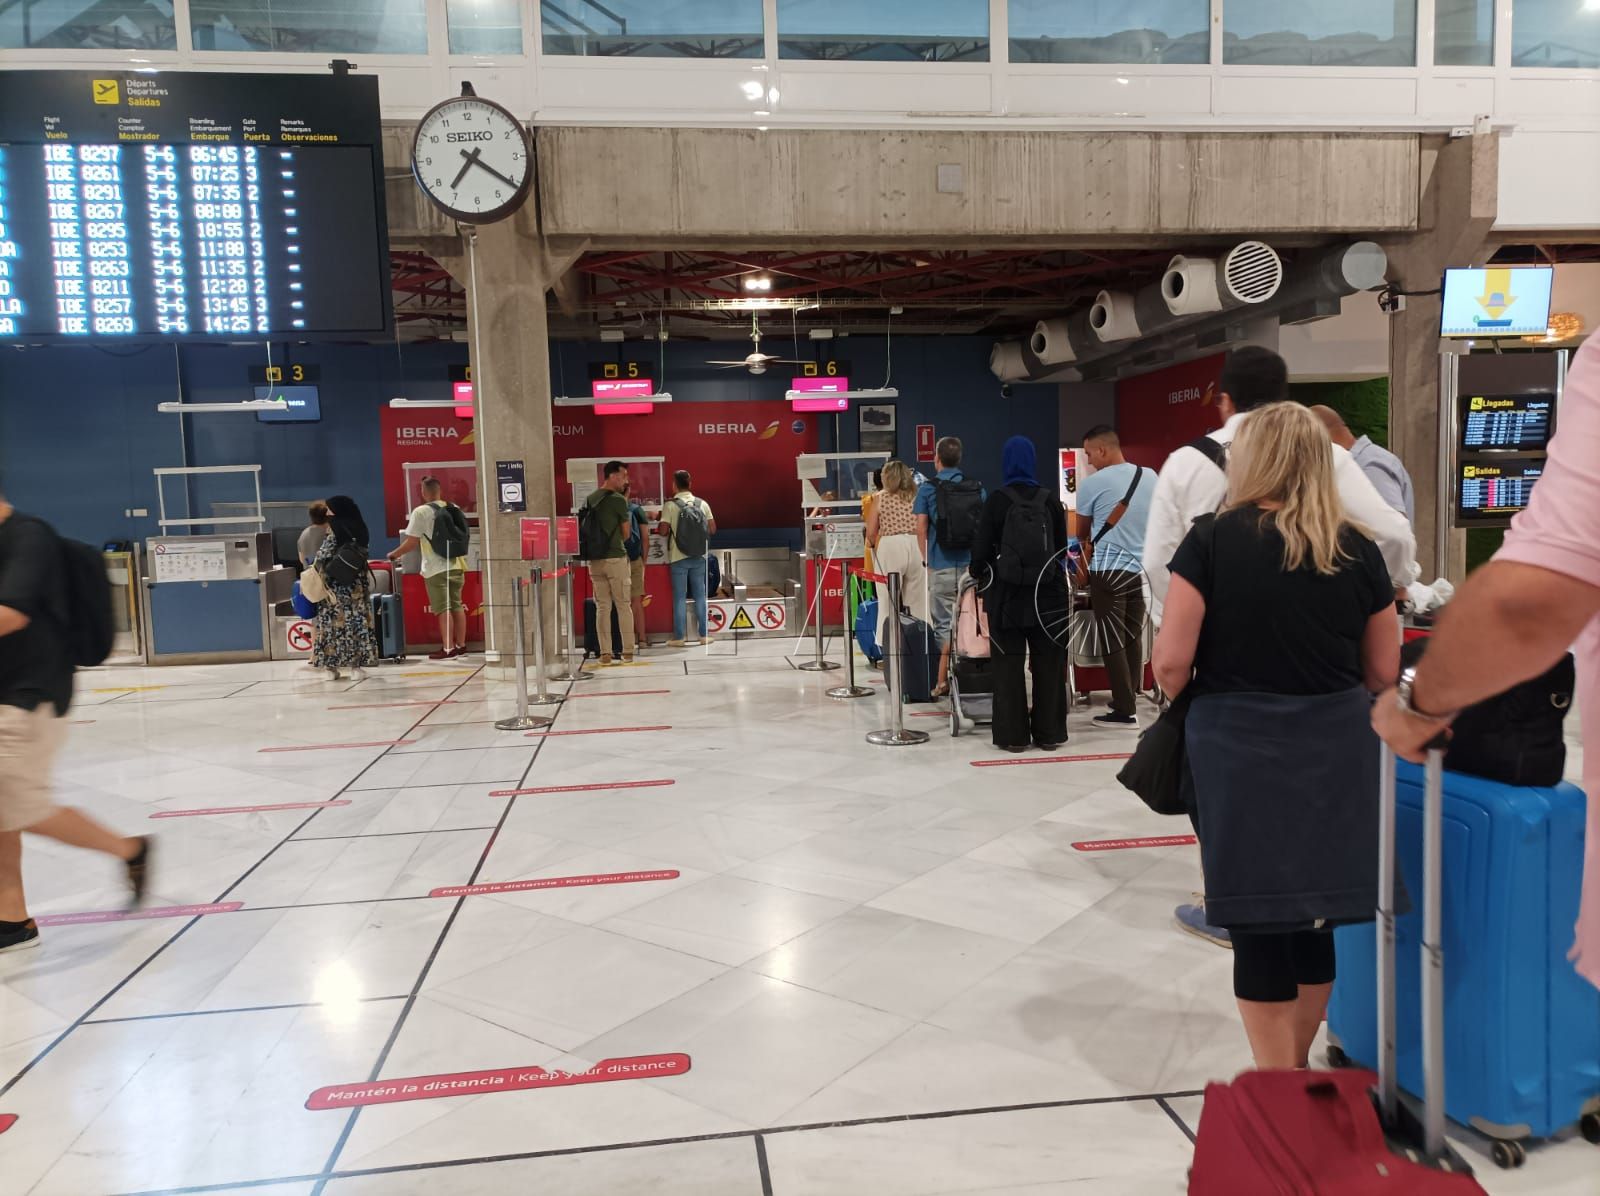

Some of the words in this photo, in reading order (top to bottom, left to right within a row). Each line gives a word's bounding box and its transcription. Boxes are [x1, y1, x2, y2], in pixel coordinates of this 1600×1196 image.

[127, 87, 168, 96] Departures
[128, 96, 160, 106] Salidas
[462, 112, 472, 121] 12
[442, 119, 449, 127] 11
[45, 131, 68, 139] Vuelo
[118, 132, 160, 140] Mostrador
[190, 133, 230, 141] Embarque
[243, 133, 271, 141] Puerta
[281, 133, 338, 141] Observaciones
[430, 135, 439, 144] 10
[446, 130, 493, 143] SEIKO
[504, 131, 511, 140] 2
[44, 144, 75, 161] IBE
[144, 146, 176, 162] 5-6
[245, 147, 257, 163] 2
[512, 152, 519, 161] 3
[425, 157, 432, 166] 9
[45, 164, 76, 181] IBE
[146, 165, 178, 181] 5-6
[246, 166, 259, 181] 3
[435, 178, 442, 187] 8
[48, 184, 78, 200] IBE
[147, 184, 179, 200] 5-6
[248, 185, 260, 200] 2
[495, 190, 501, 198] 5
[474, 196, 480, 205] 6
[49, 203, 80, 219] IBE
[149, 203, 180, 219] 5-6
[250, 204, 260, 219] 1
[50, 222, 81, 238] IBE
[150, 222, 182, 238] 5-6
[250, 222, 263, 238] 2
[52, 241, 83, 257] IBE
[151, 241, 184, 256] 5-6
[252, 241, 264, 257] 3
[54, 260, 84, 276] IBE
[153, 260, 185, 275] 5-6
[253, 260, 265, 275] 2
[55, 280, 86, 295] IBE
[155, 279, 186, 294] 5-6
[255, 278, 266, 294] 2
[57, 298, 88, 314] IBE
[156, 297, 188, 313] 5-6
[256, 297, 268, 312] 3
[59, 317, 89, 333] IBE
[158, 316, 189, 331] 5-6
[257, 315, 270, 331] 2
[292, 365, 304, 381] 3
[628, 363, 638, 377] 5
[827, 361, 836, 376] 6
[1168, 387, 1200, 405] IBERIA
[1482, 399, 1514, 409] Llegadas
[396, 427, 459, 438] IBERIA
[698, 423, 757, 434] IBERIA
[1475, 467, 1500, 475] Salidas
[824, 588, 845, 597] IBE
[327, 1084, 397, 1101] Mantén
[402, 1083, 418, 1093] la
[423, 1075, 504, 1092] distancia
[517, 1071, 560, 1083] Keep
[607, 1060, 677, 1074] distance
